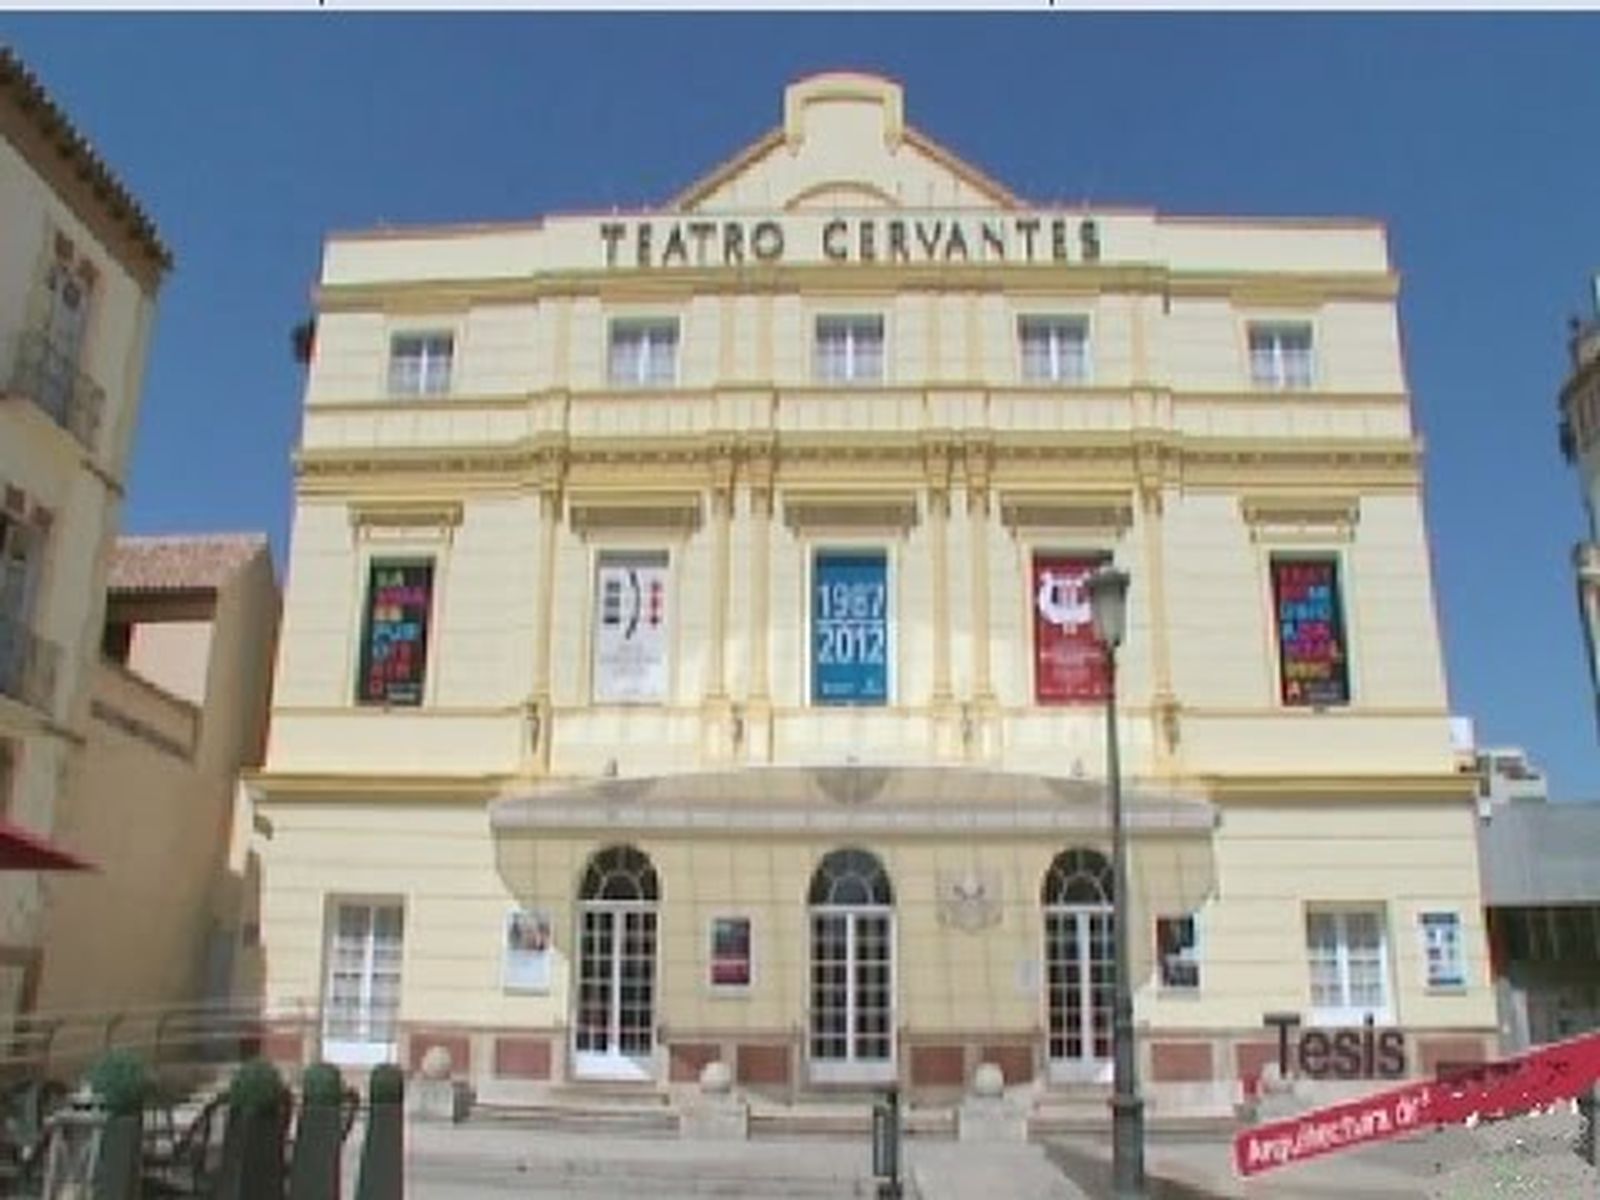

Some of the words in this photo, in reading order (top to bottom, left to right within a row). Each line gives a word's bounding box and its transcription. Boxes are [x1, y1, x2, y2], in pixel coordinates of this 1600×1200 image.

[600, 223, 785, 268] TEATRO
[822, 219, 1102, 264] CERVANTES
[819, 583, 886, 619] 1987
[819, 625, 885, 663] 2012
